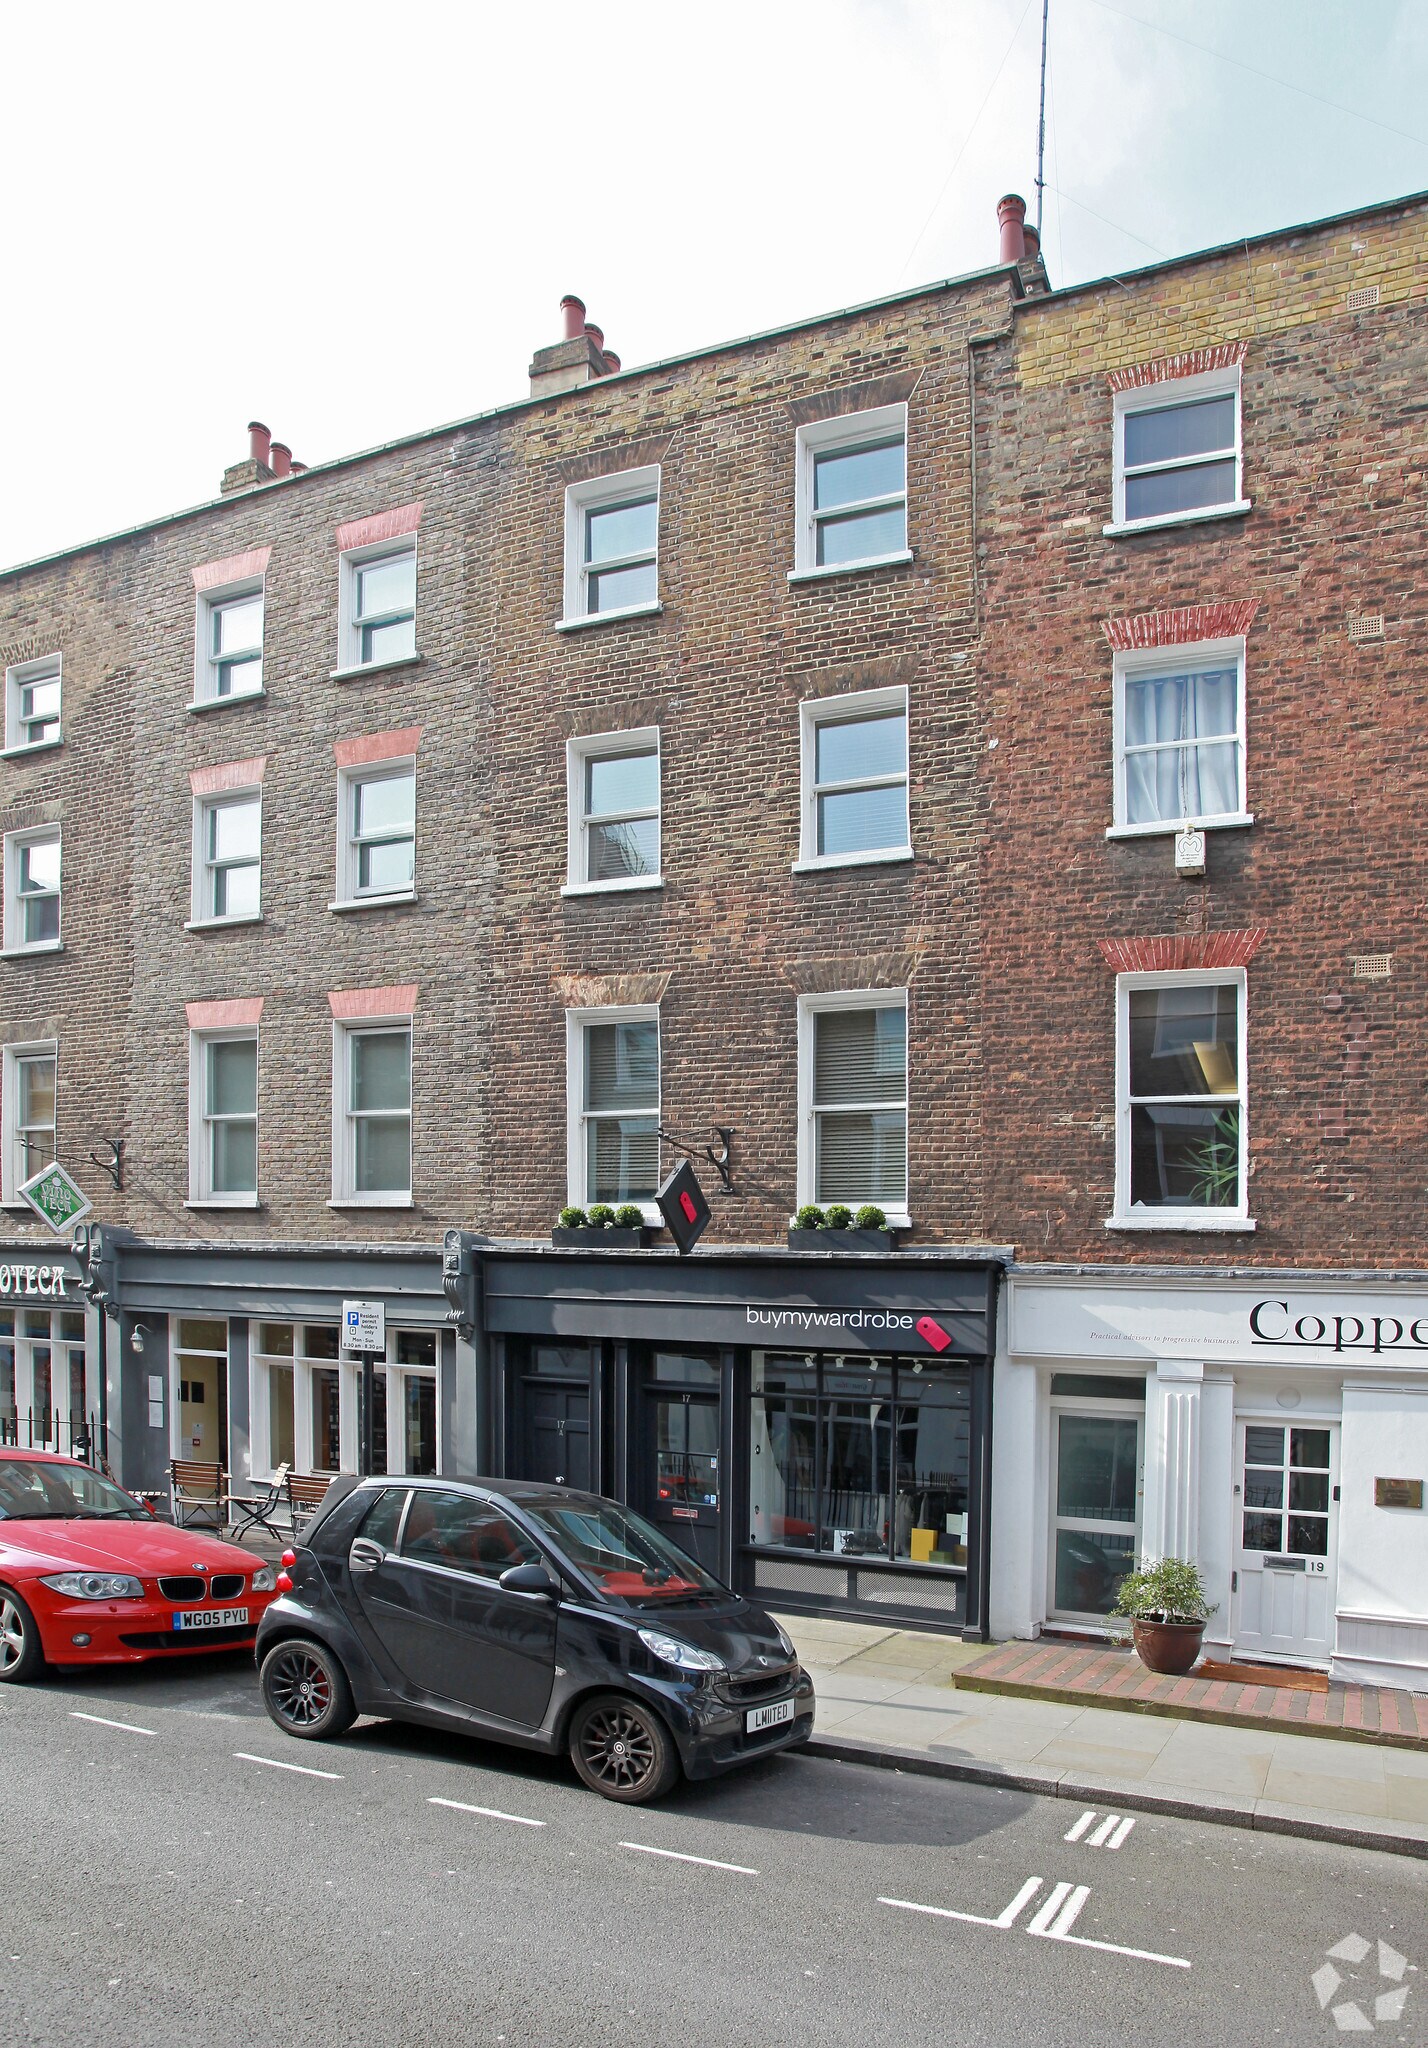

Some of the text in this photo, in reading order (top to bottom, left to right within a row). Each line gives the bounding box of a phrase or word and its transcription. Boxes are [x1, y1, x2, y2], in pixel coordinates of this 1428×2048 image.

[746, 1305, 913, 1330] buymywardrobe
[1089, 1331, 1121, 1340] Practical
[1123, 1333, 1151, 1341] advisors
[1162, 1335, 1201, 1344] progressive
[1203, 1336, 1240, 1345] businesses
[682, 1394, 691, 1402] 17
[557, 1420, 565, 1429] 17
[1311, 1562, 1324, 1572] 19
[223, 1609, 247, 1624] PYU
